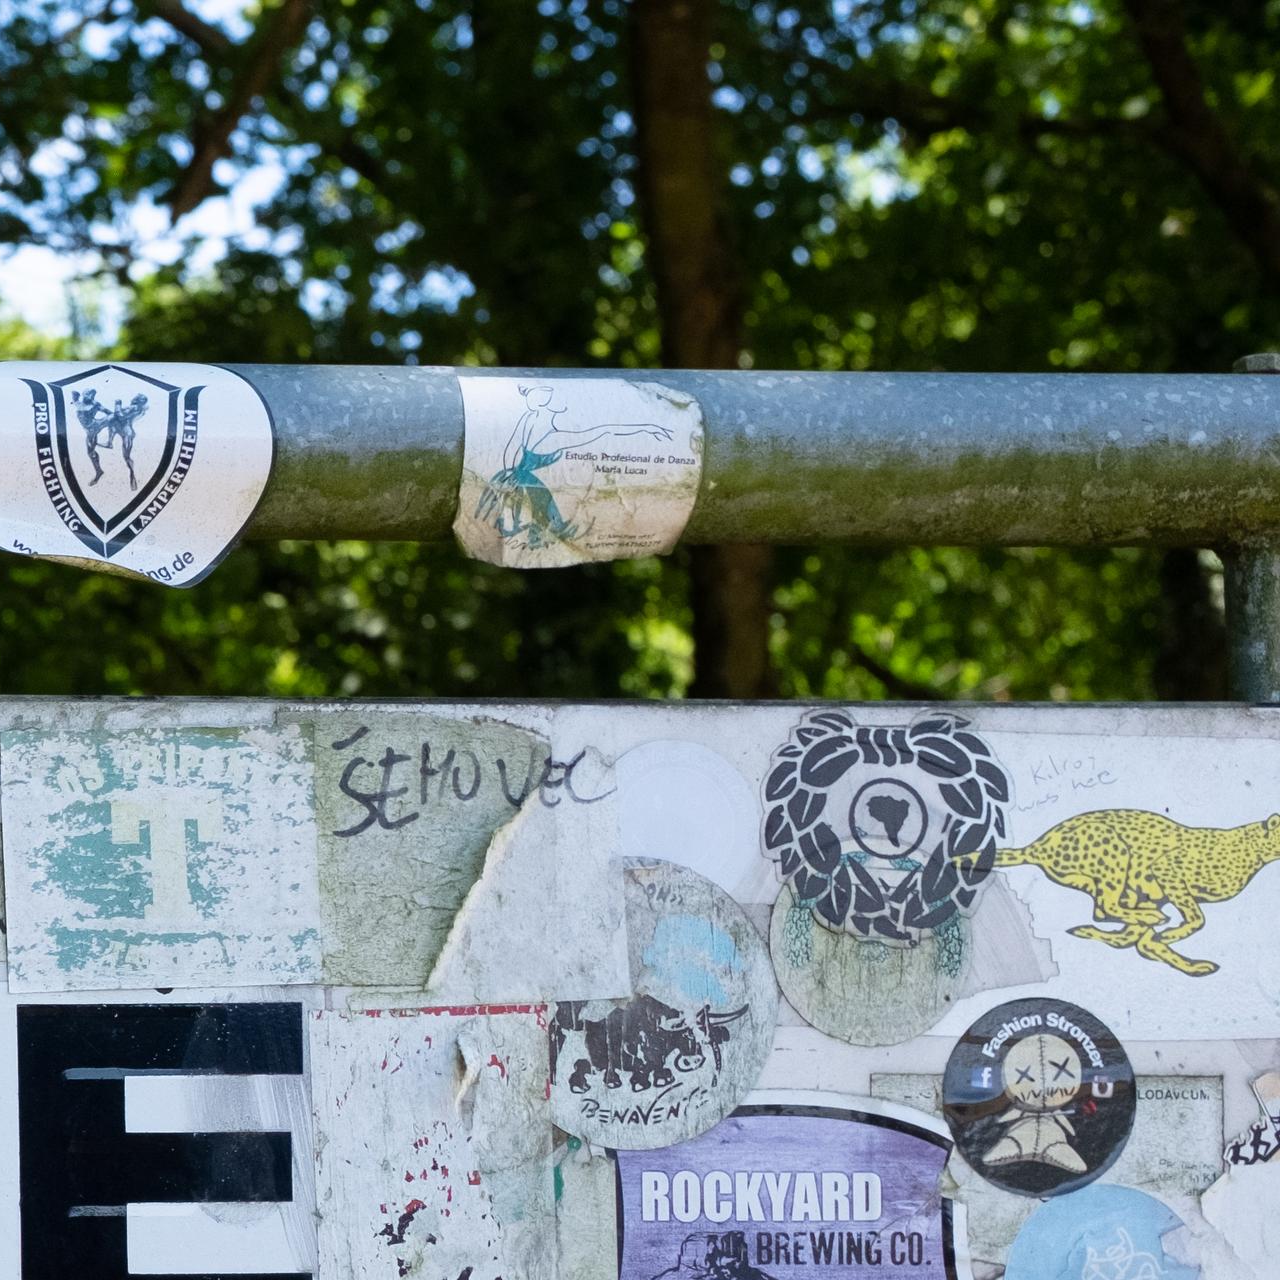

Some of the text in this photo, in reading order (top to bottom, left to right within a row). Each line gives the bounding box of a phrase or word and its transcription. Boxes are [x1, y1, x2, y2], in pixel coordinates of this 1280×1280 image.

[32, 401, 82, 533] PRO FIGHTING
[129, 408, 199, 535] LAMPERTHEIM
[624, 466, 648, 475] Lucas
[653, 455, 666, 464] de
[668, 456, 696, 465] Danza
[981, 1012, 1105, 1069] Fashion Stronzer
[641, 1170, 882, 1223] ROCKYARD
[756, 1230, 932, 1266] BREWING CO.
